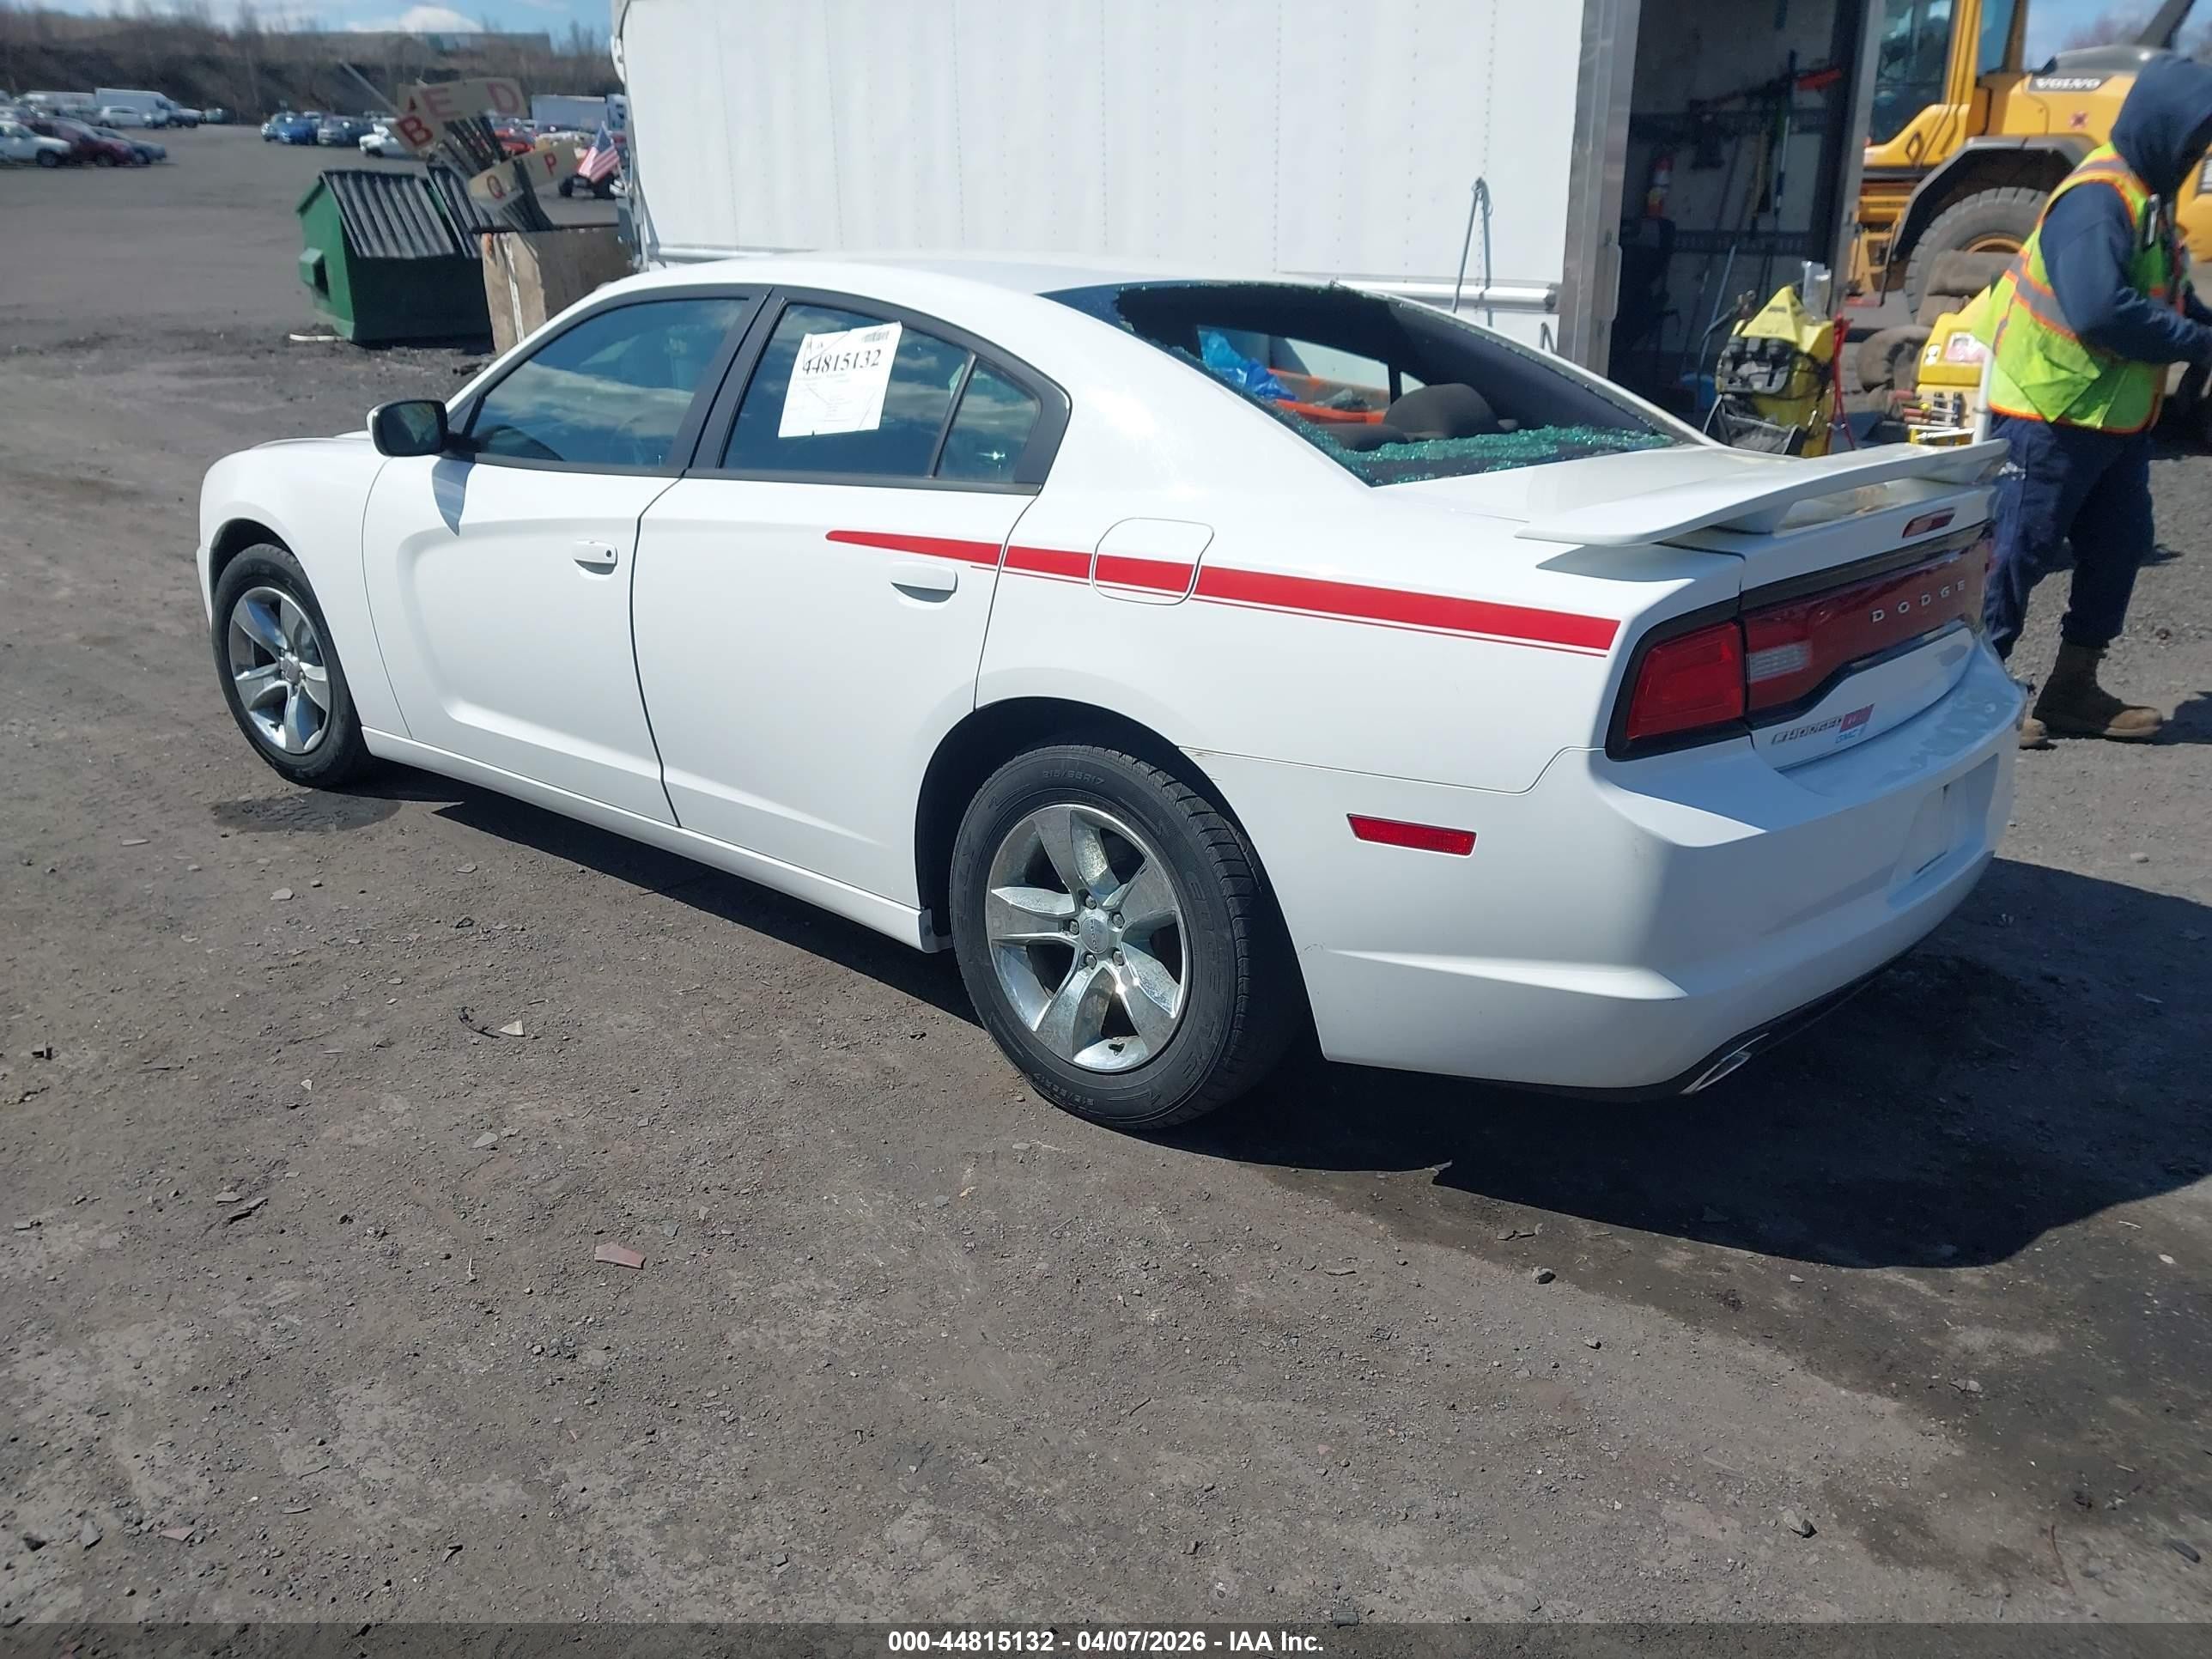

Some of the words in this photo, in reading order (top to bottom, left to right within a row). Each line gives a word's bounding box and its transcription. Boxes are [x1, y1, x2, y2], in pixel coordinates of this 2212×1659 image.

[2035, 77, 2102, 90] VOLVO
[487, 82, 520, 115] D
[398, 115, 434, 147] B
[544, 152, 557, 177] P
[802, 348, 882, 375] 44815132
[1871, 579, 1966, 623] DODGE
